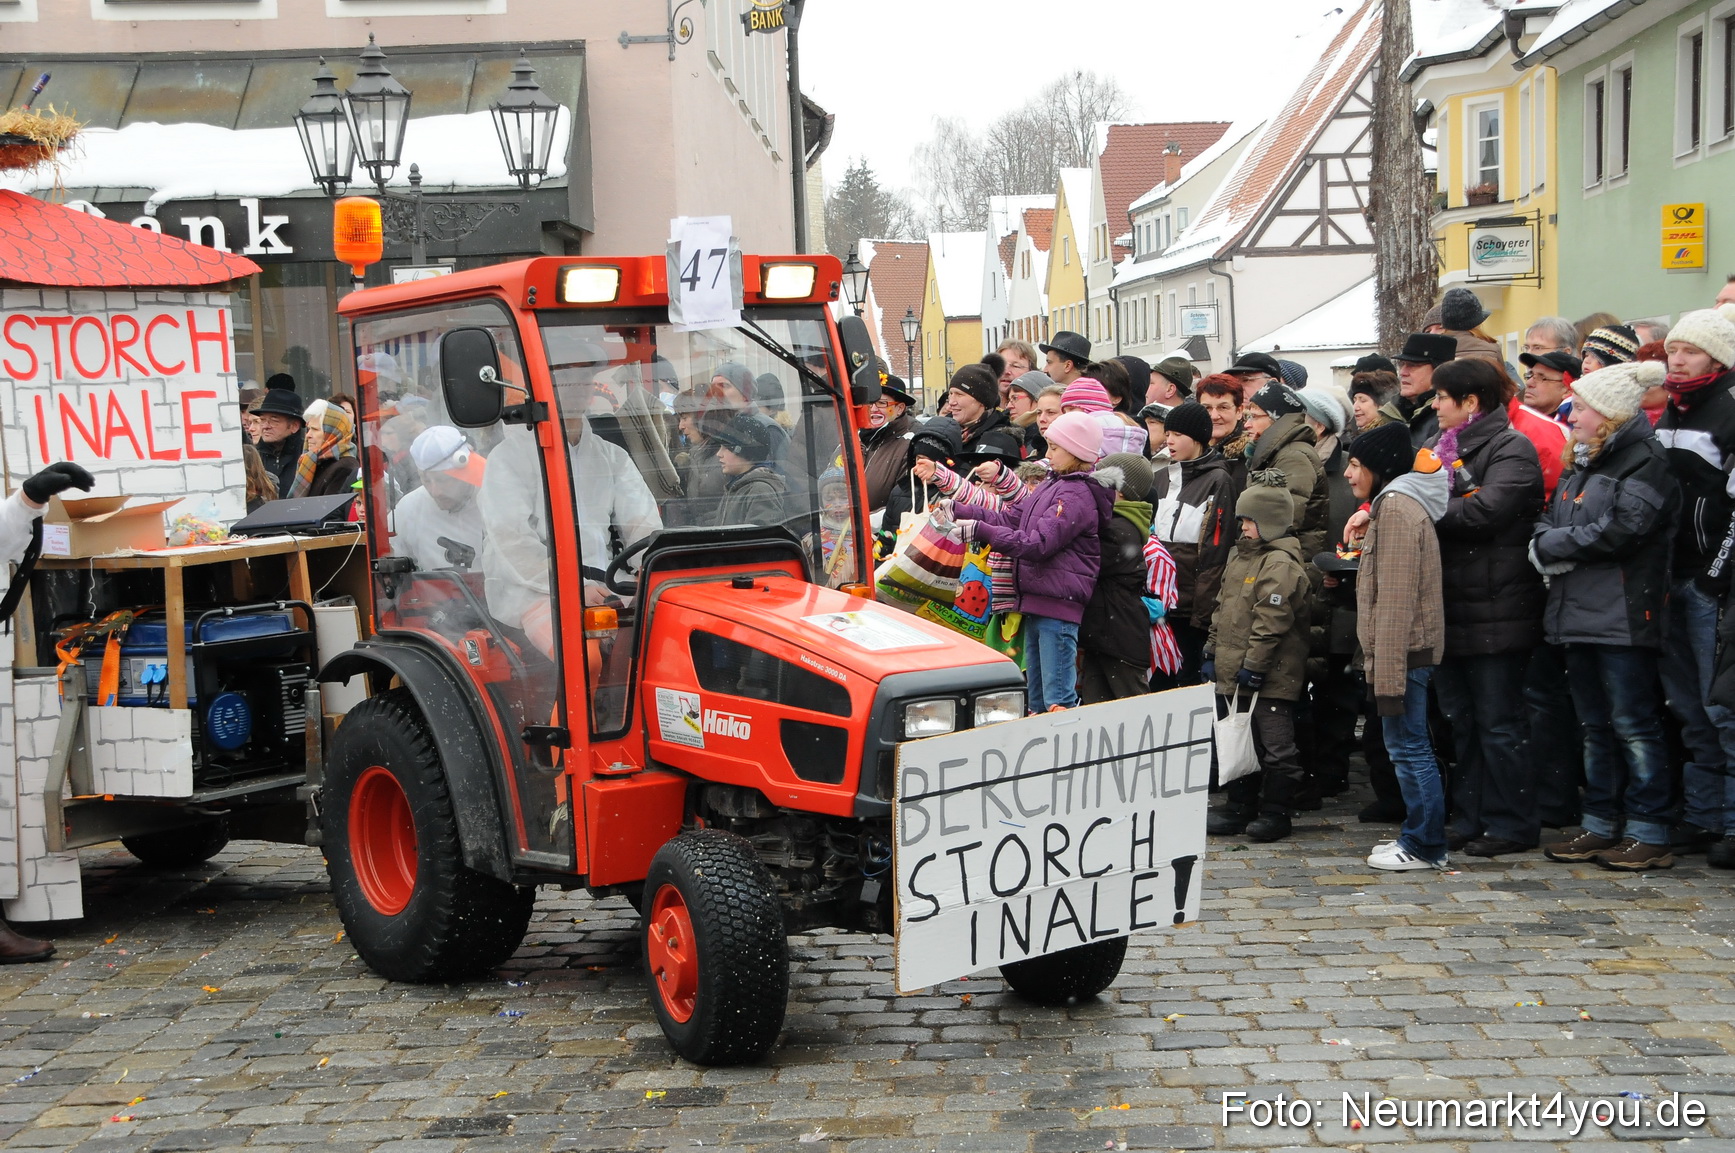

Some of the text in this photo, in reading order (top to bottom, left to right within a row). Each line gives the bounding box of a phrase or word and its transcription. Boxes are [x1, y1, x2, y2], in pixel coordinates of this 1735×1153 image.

[750, 8, 784, 29] BANK
[1668, 232, 1697, 240] DHL
[680, 248, 727, 292] 47
[3, 309, 230, 381] STORCH
[34, 389, 222, 465] INALE
[800, 653, 847, 682] Hakotrac 3000 DA
[703, 708, 753, 741] Hako
[900, 707, 1213, 847] BERCHINALE
[907, 810, 1155, 922] STORCH
[971, 855, 1198, 966] INALE!
